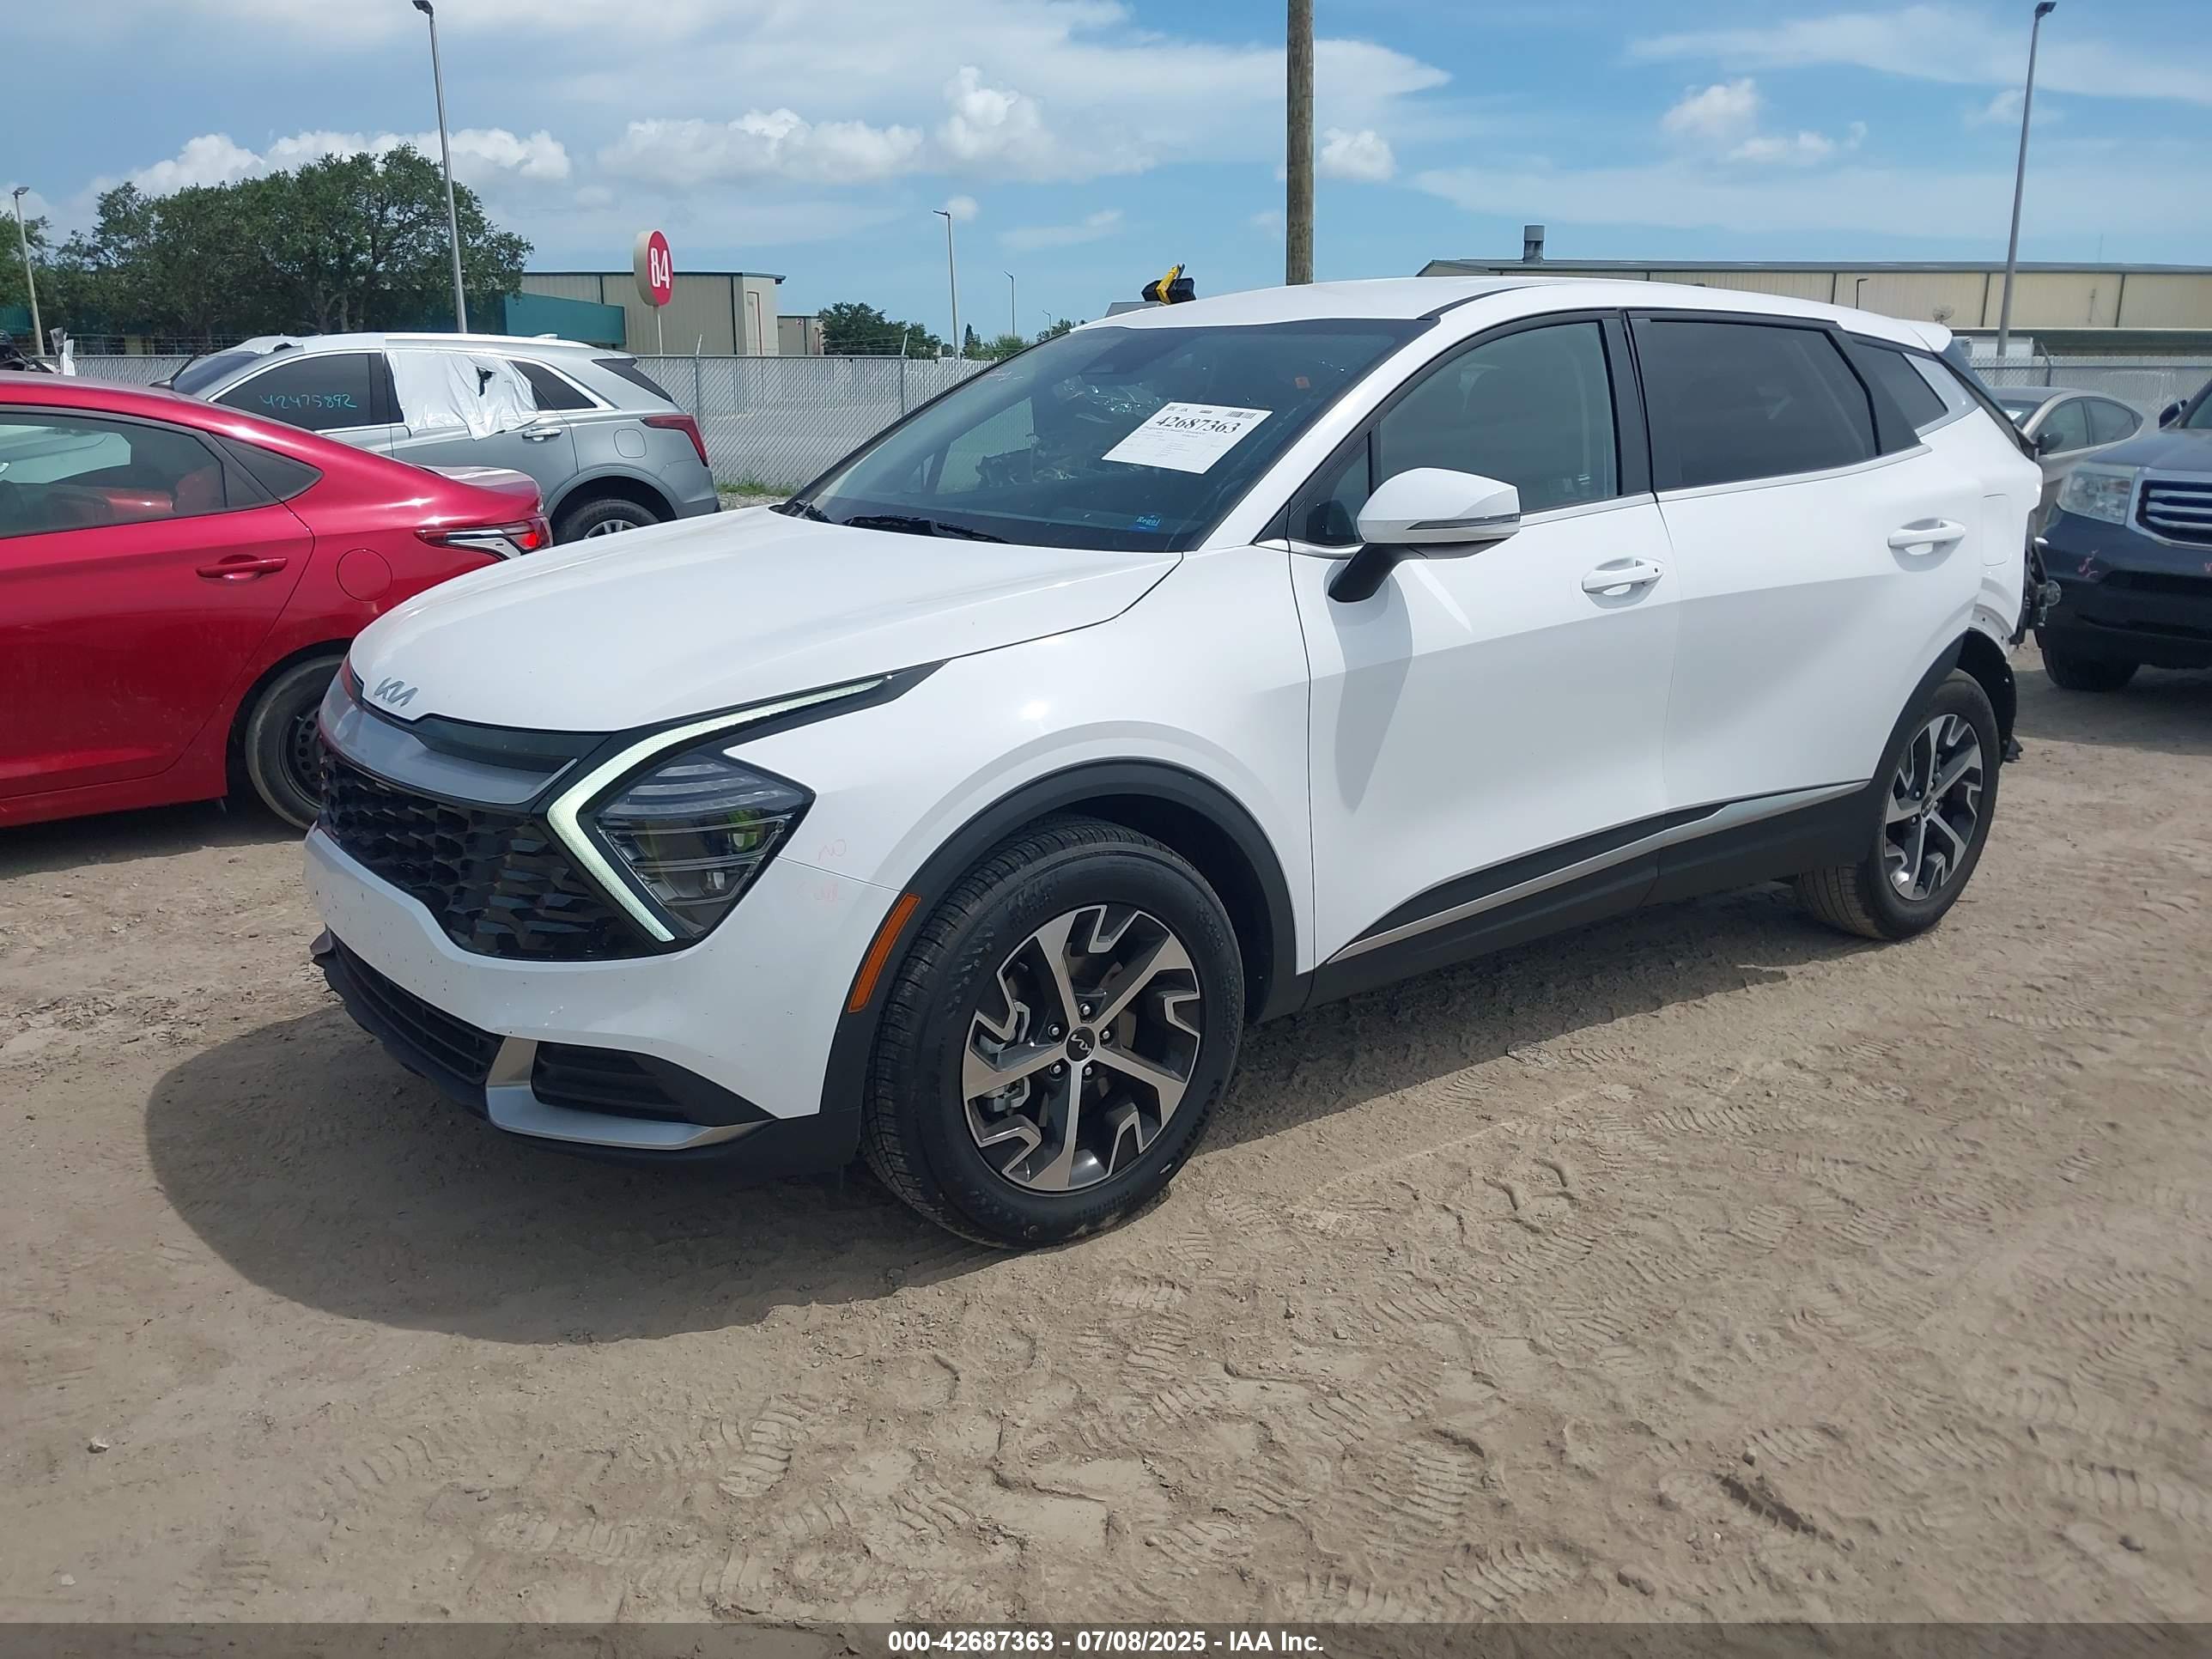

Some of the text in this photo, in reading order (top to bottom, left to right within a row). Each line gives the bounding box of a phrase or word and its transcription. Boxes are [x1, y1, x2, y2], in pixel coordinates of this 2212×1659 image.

[650, 247, 670, 289] 84
[259, 394, 357, 409] 42475892
[1156, 416, 1241, 434] 42687363
